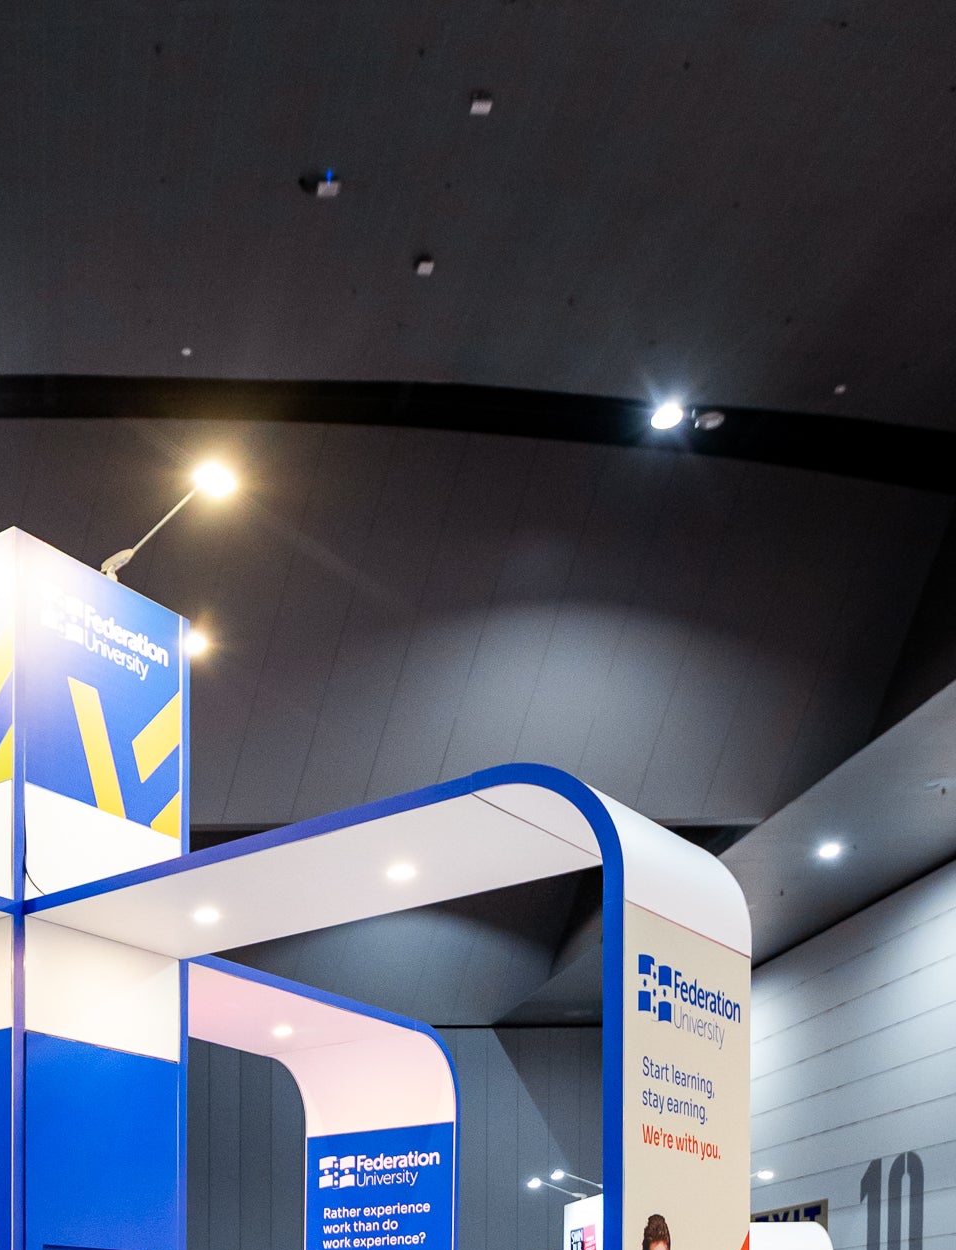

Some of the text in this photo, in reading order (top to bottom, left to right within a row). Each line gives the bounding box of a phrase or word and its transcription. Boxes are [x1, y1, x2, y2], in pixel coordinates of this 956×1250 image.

[84, 604, 169, 667] Federation
[85, 630, 149, 680] University
[674, 970, 741, 1023] Federation
[674, 1004, 725, 1050] University
[643, 1056, 715, 1099] Start learning,
[642, 1089, 708, 1124] stay earning.
[642, 1124, 720, 1160] We're with you.
[357, 1151, 440, 1172] Federation
[357, 1170, 418, 1186] University
[323, 1202, 430, 1219] Rather experience
[323, 1219, 398, 1234] work than do
[323, 1232, 426, 1249] work experience?
